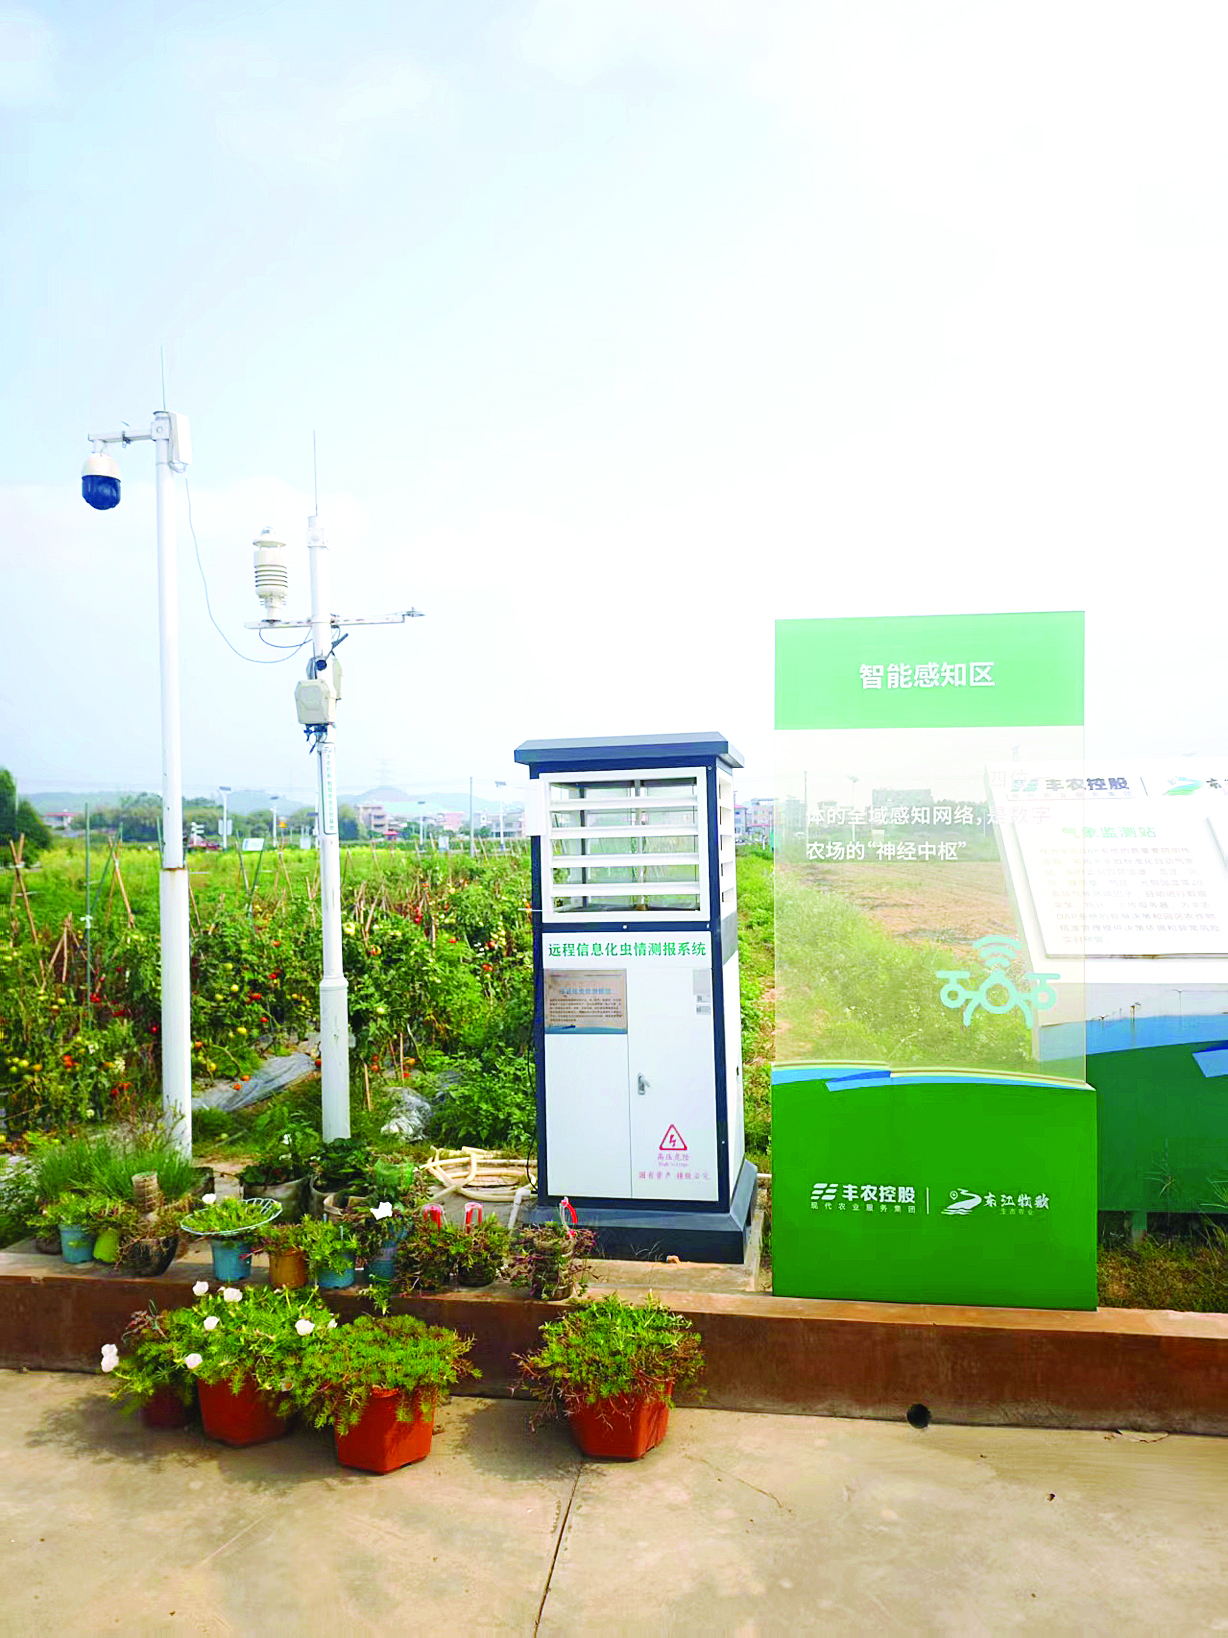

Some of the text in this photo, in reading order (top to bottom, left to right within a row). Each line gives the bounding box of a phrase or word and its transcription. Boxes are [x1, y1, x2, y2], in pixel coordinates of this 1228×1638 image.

[858, 661, 996, 690] 智能感知区
[1044, 777, 1130, 792] 丰农控股
[1061, 826, 1157, 839] 气象监测站
[548, 941, 707, 957] 远程信息化虫情测报系统
[841, 1184, 1050, 1209] 丰农控股 东江牧歌
[810, 1201, 917, 1214] 现代农业服务集团
